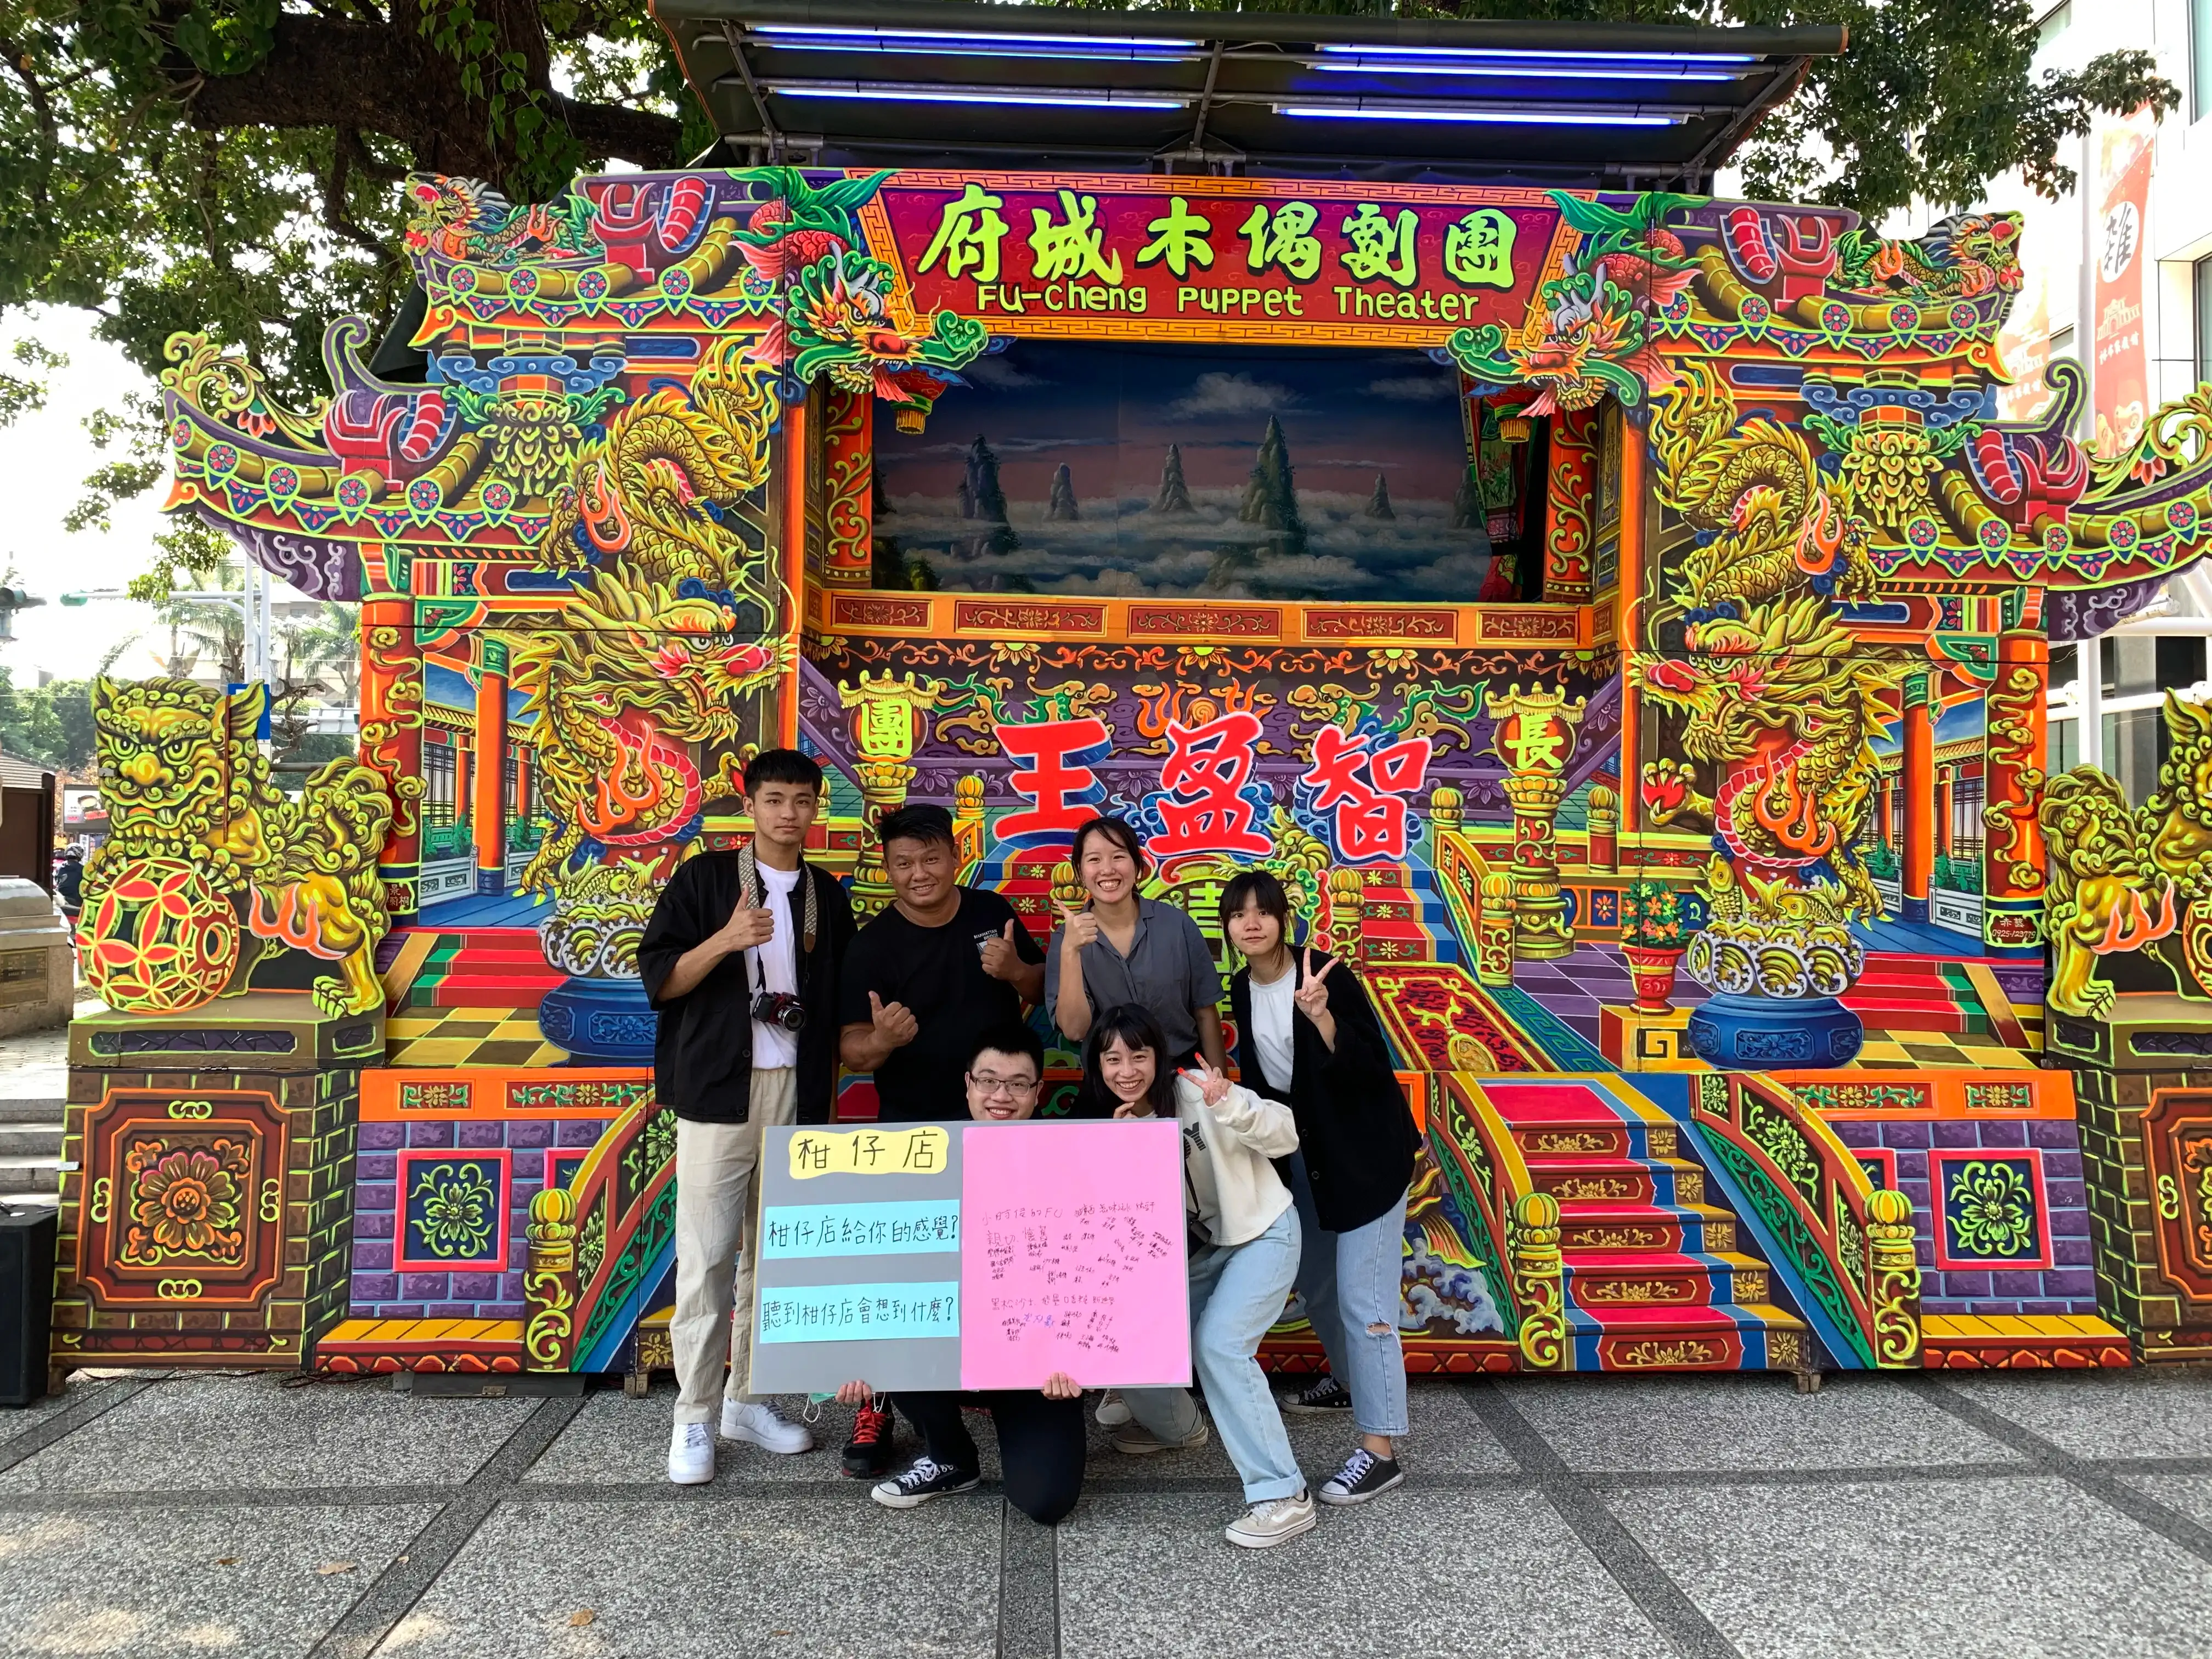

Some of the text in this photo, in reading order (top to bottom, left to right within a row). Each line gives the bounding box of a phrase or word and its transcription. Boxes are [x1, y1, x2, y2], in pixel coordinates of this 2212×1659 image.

[1334, 286, 1480, 321] Theater
[862, 698, 913, 758] 團
[1504, 713, 1565, 770] 長
[992, 710, 1433, 863] 王盈智
[973, 929, 997, 939] MANHATTAN
[798, 1130, 938, 1169] 柑仔店
